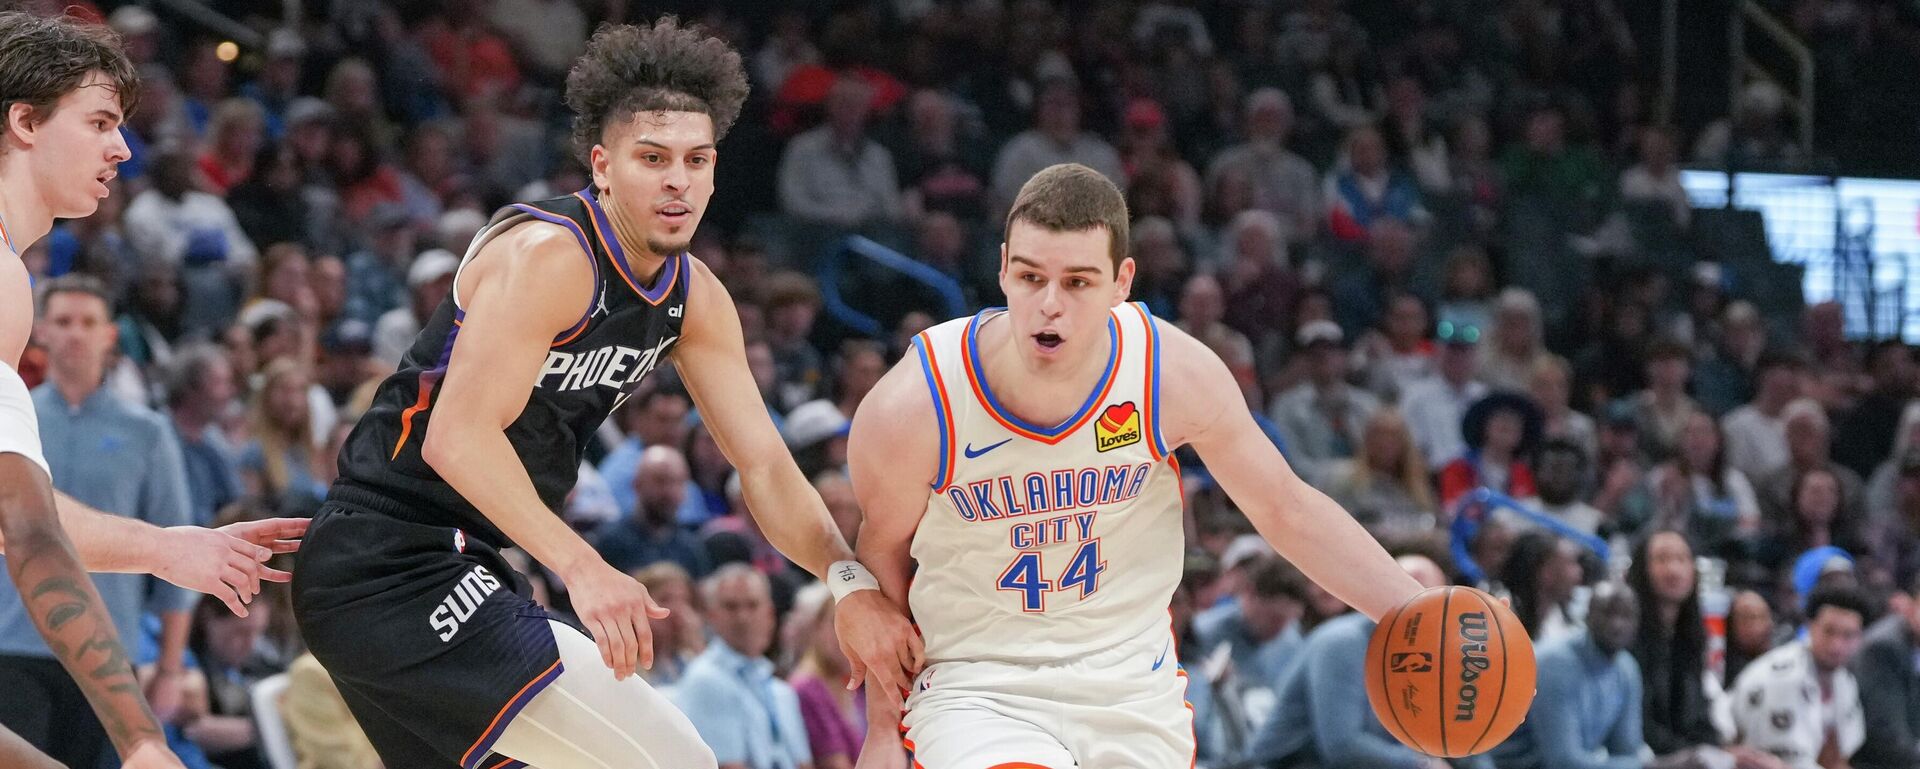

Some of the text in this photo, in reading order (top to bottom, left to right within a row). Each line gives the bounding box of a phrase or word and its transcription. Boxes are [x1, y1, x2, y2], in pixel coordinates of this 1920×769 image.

[947, 462, 1151, 522] OKLAHOMA
[1011, 511, 1097, 549] CITY
[996, 537, 1108, 612] 44
[1455, 611, 1490, 722] Wilson
